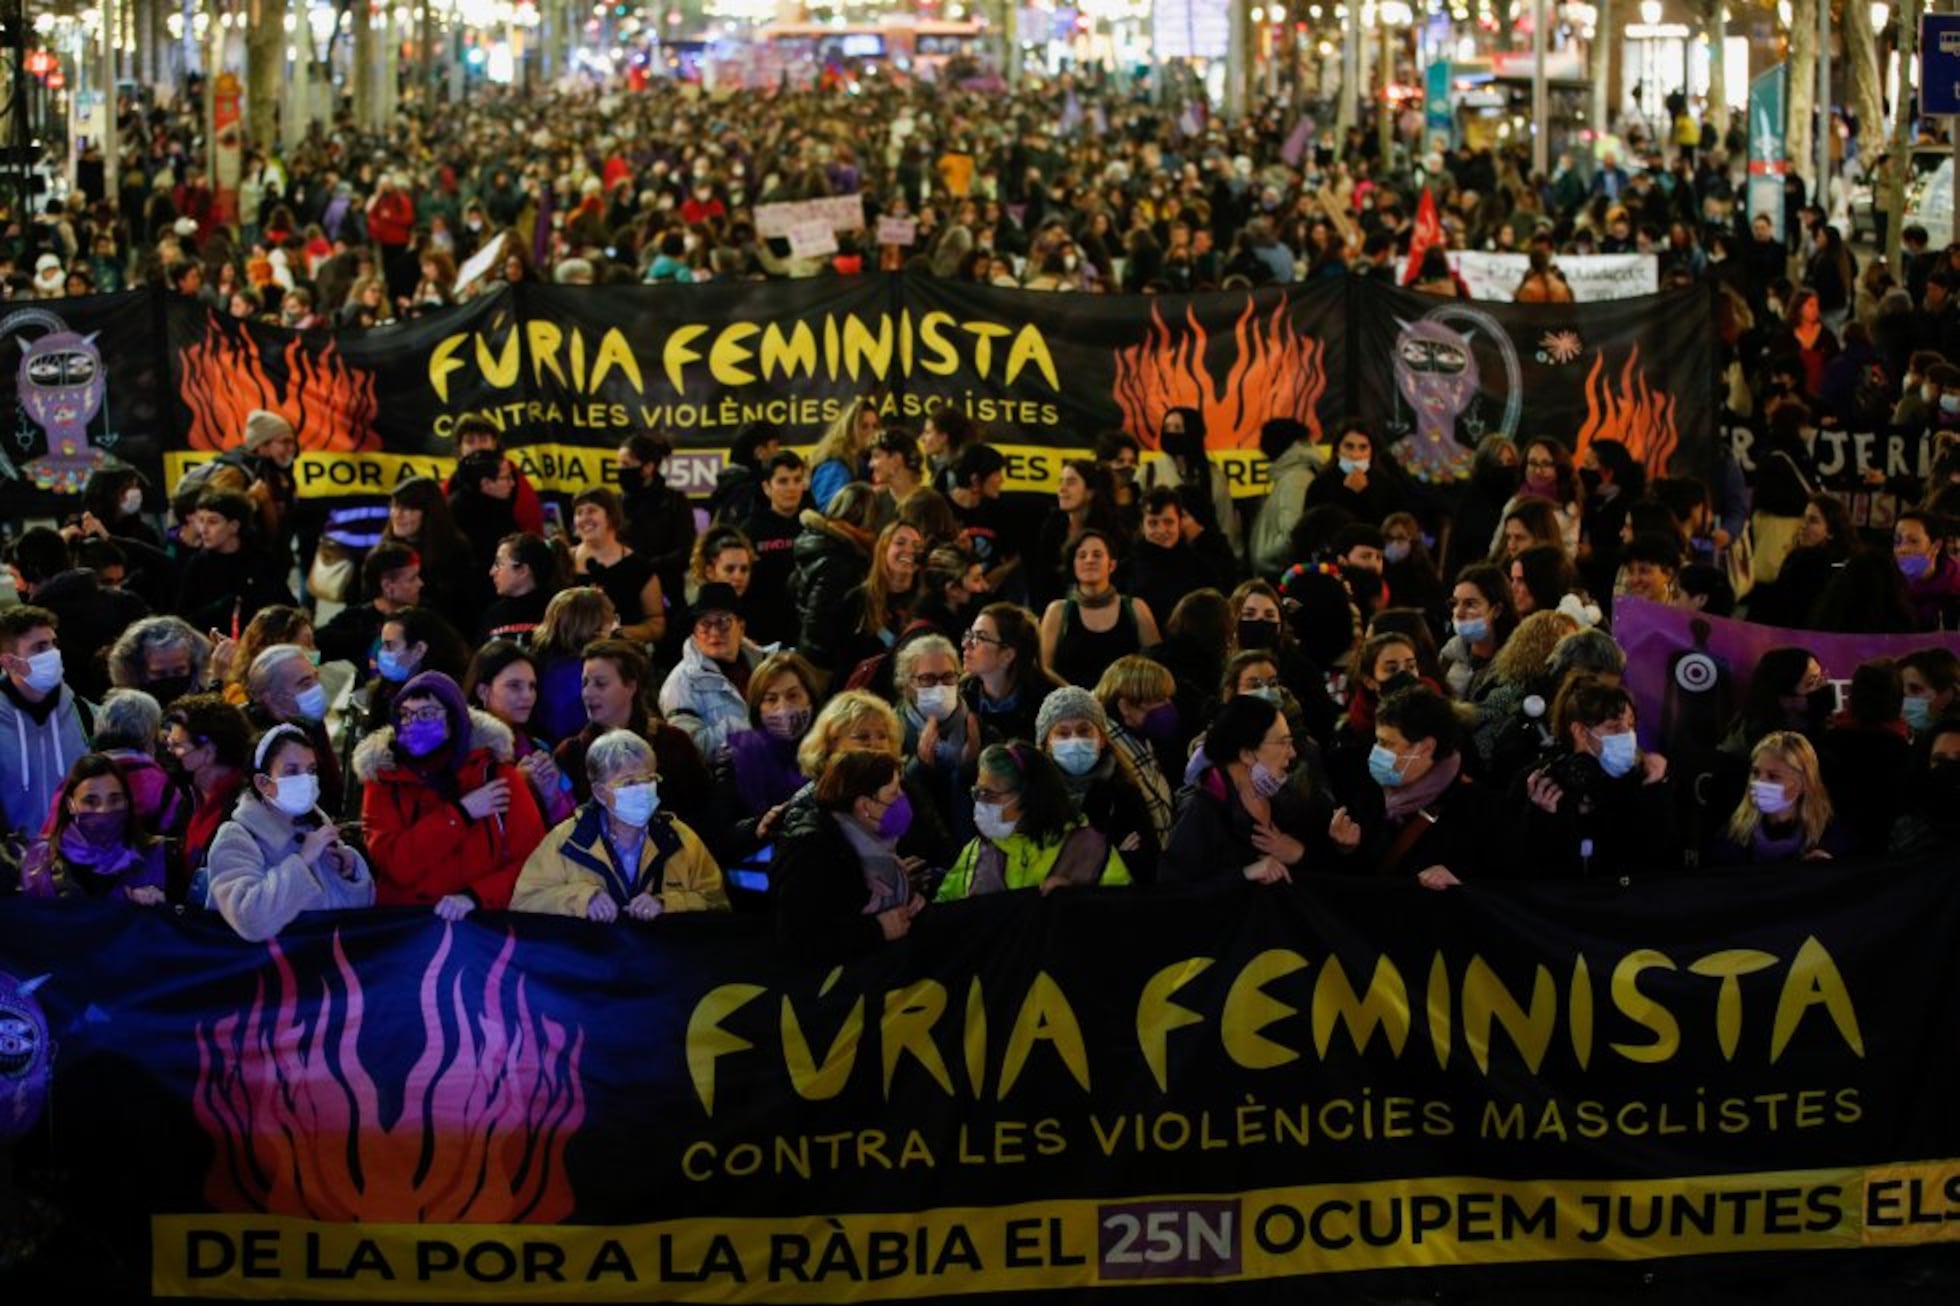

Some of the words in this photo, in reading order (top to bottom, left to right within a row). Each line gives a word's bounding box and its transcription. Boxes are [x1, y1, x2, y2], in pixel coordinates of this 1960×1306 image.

[429, 310, 645, 404] FÚRIA
[662, 307, 1061, 396] FEMINISTA
[573, 403, 629, 429] LES
[303, 460, 383, 487] POR
[520, 449, 588, 485] ÀBIA
[664, 458, 719, 487] 5N
[685, 966, 1091, 1118] FÚRIA
[1136, 935, 1865, 1094] FEMINISTA
[681, 1129, 935, 1182] CONTRA
[959, 1117, 1067, 1165] LES
[186, 1229, 282, 1279] DE
[306, 1232, 395, 1281] LA
[417, 1240, 567, 1283] POR
[588, 1239, 639, 1283] A
[659, 1231, 747, 1284] LA
[768, 1217, 985, 1284] RÀBIA
[1005, 1218, 1086, 1269] EL
[1102, 1209, 1234, 1265] 25N
[1254, 1192, 1559, 1257] OCUPEM
[1577, 1183, 1843, 1244] JUNTES
